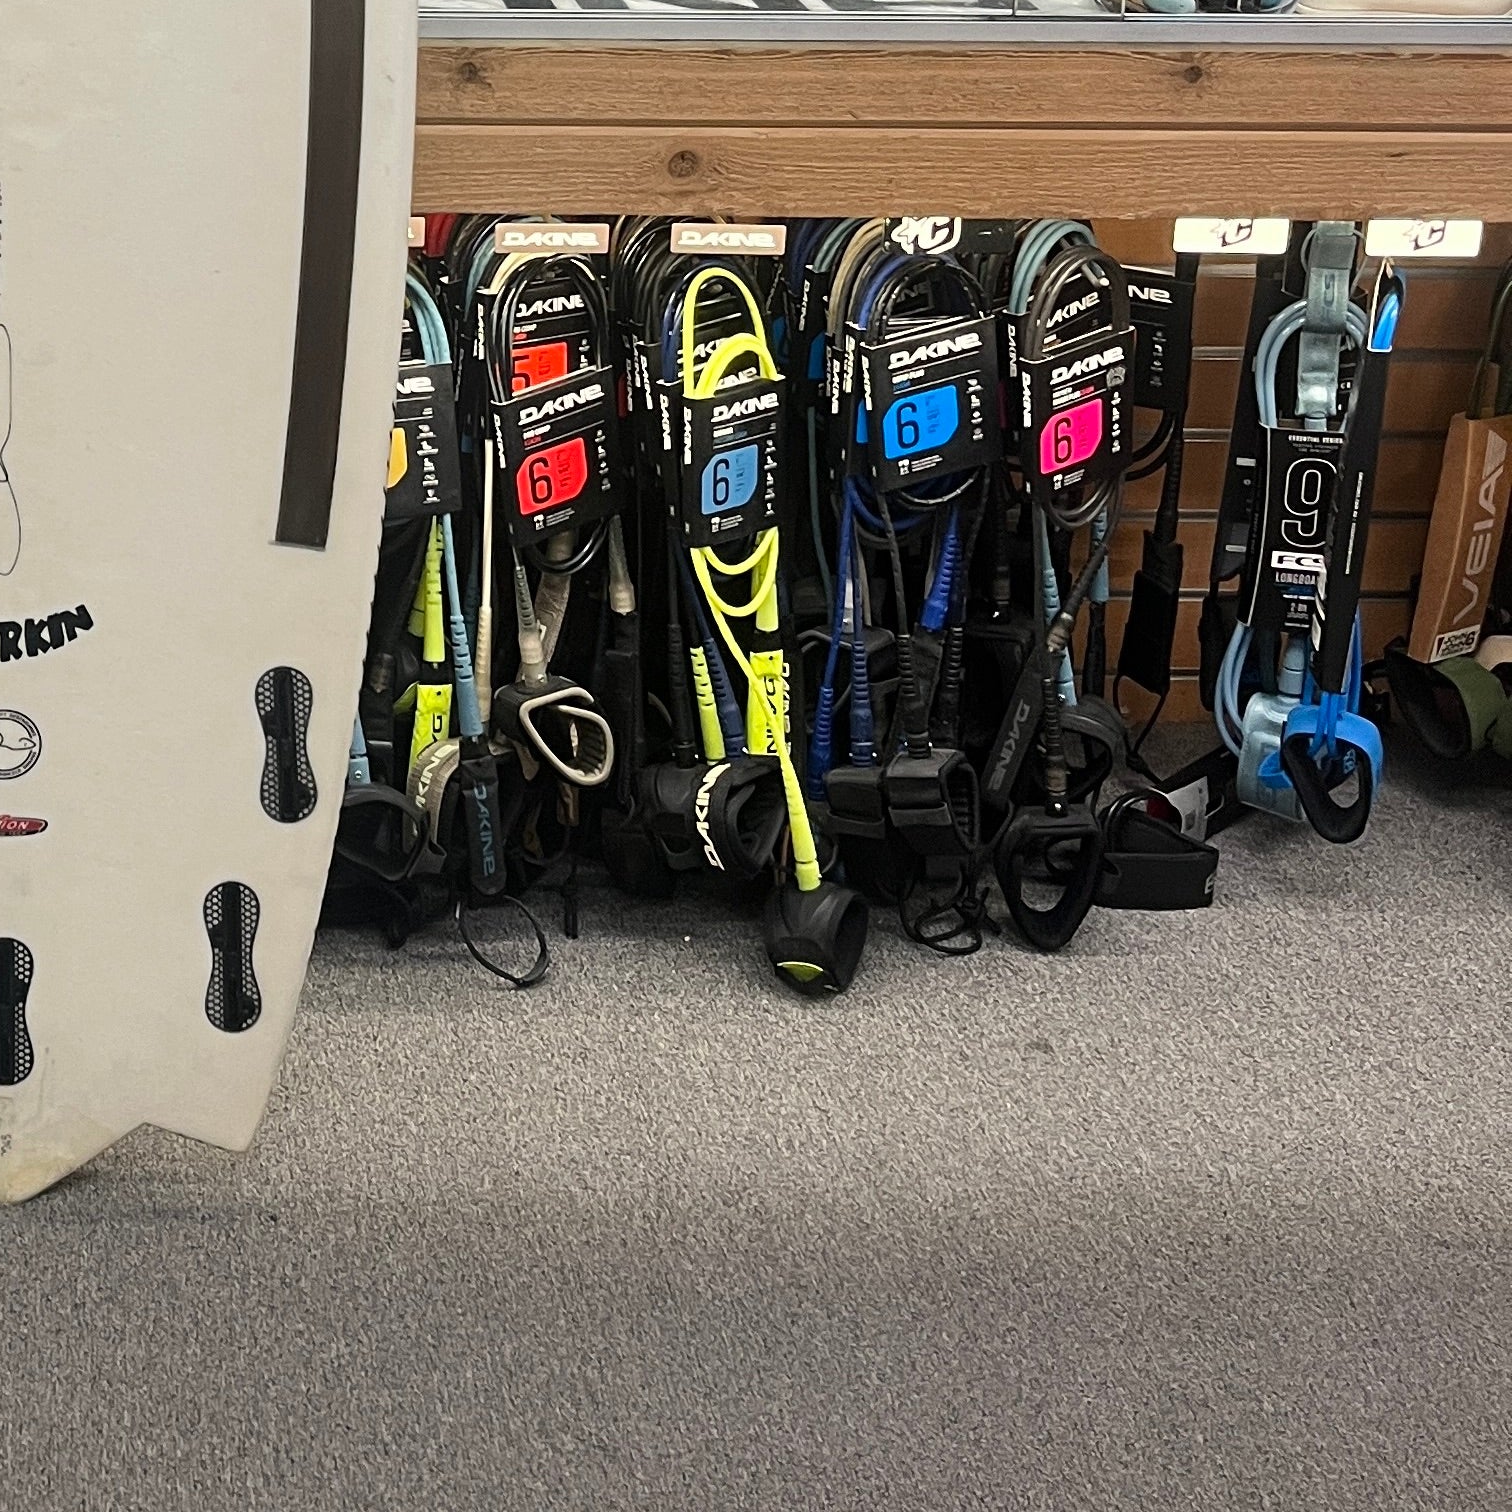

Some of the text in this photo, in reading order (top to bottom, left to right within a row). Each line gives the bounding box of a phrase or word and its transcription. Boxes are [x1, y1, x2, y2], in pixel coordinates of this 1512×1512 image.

[501, 230, 599, 248] DAKINE
[677, 230, 776, 248] DAKINE
[516, 293, 585, 318] DAKINE
[1046, 291, 1101, 328] AKINE
[888, 332, 983, 370] DAKINE
[1050, 346, 1125, 385] DAKINE
[518, 384, 604, 426] DAKINE
[712, 392, 779, 423] DAKINE
[896, 402, 920, 449] 6
[1053, 416, 1072, 464] 6
[528, 456, 553, 505] 6
[713, 457, 729, 505] 6
[1282, 458, 1337, 548] 9
[1276, 554, 1325, 567] FCS
[988, 699, 1031, 792] DAKINE
[473, 783, 497, 876] DAKINE
[694, 762, 731, 872] DAKINE
